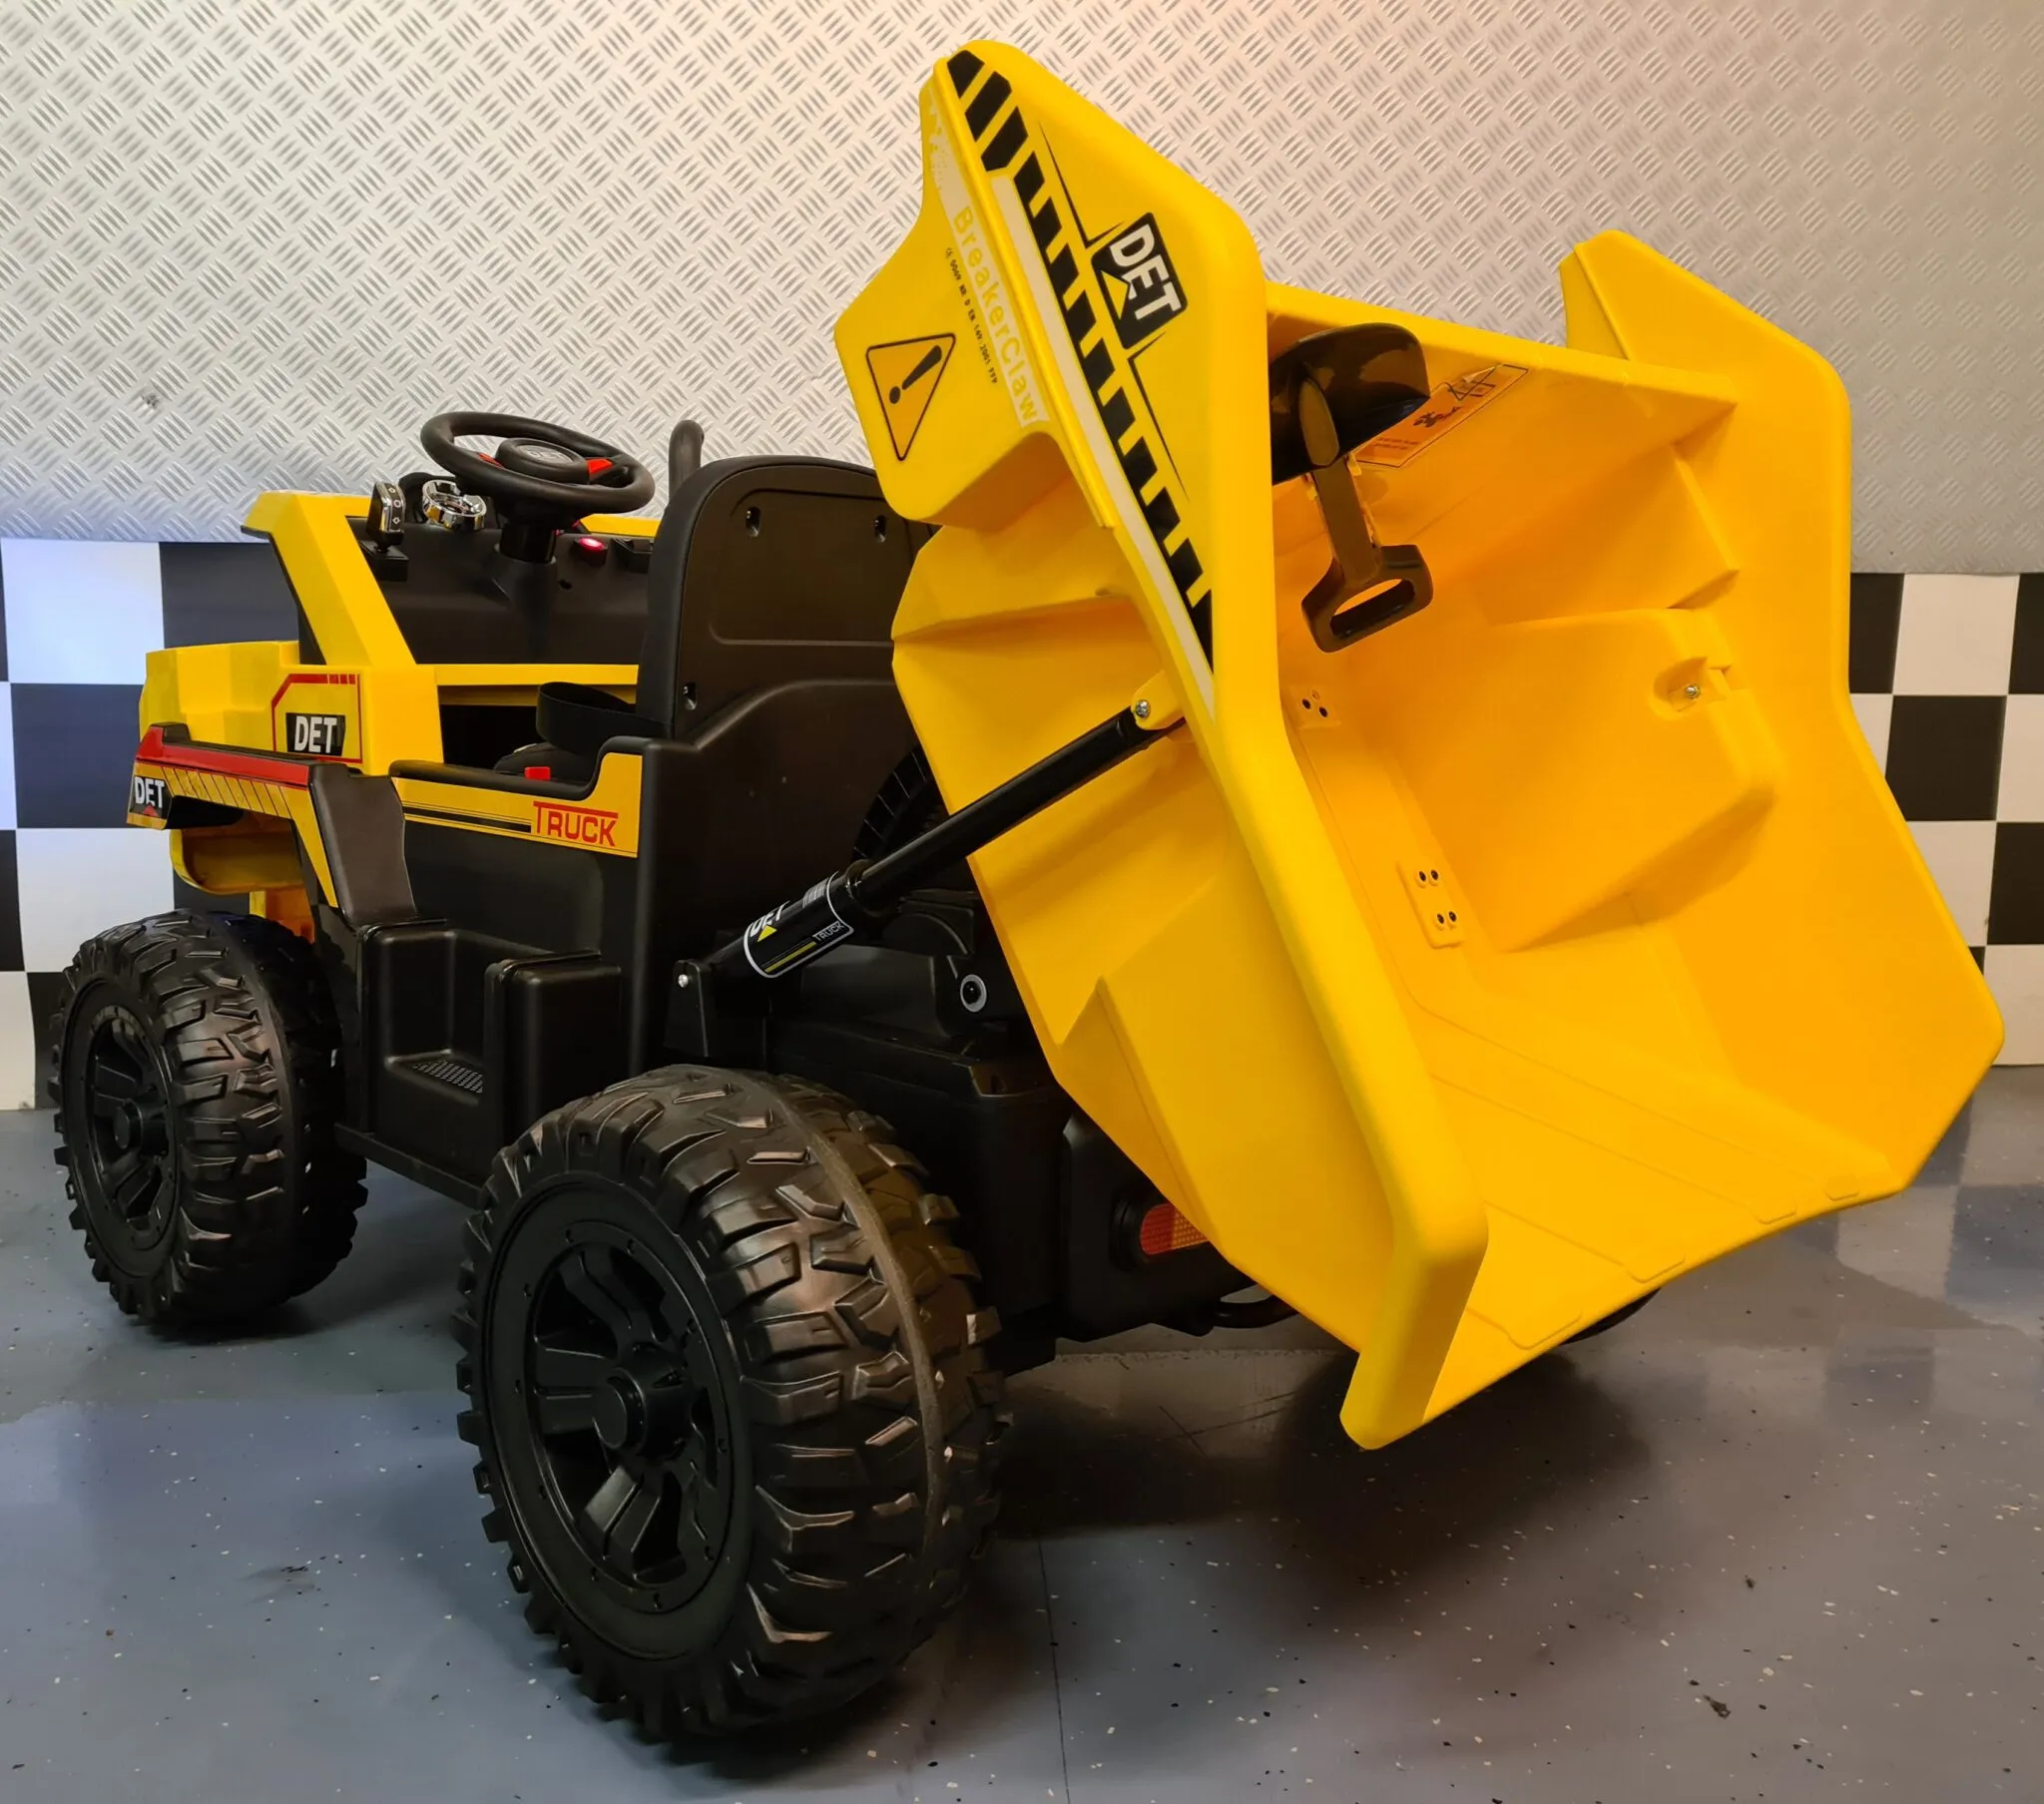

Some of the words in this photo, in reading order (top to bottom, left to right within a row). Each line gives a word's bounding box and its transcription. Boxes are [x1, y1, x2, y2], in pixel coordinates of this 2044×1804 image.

[1107, 223, 1182, 321] DET
[953, 206, 1039, 422] BreakerClaw
[293, 714, 337, 753] DET
[134, 776, 166, 809] DET
[533, 800, 619, 847] TRUCK
[812, 921, 845, 942] TRUCK
